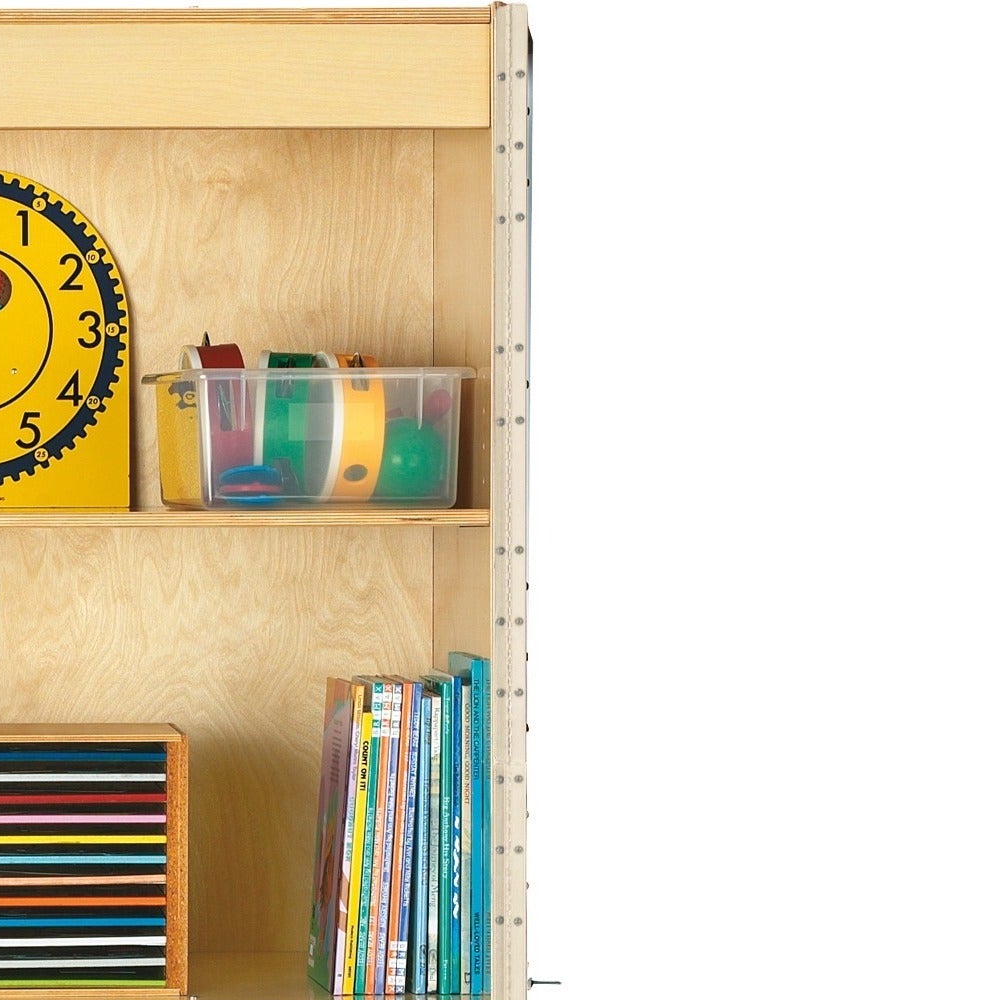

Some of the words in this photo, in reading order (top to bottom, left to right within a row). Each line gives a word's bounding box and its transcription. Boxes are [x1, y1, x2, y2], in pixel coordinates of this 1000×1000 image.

[16, 210, 29, 246] 1
[59, 253, 83, 291] 2
[78, 310, 102, 349] 3
[56, 369, 83, 407] 4
[15, 412, 41, 449] 5
[361, 740, 370, 766] COUNT
[463, 725, 471, 759] MORNING,
[359, 781, 367, 791] IT!
[360, 768, 368, 780] ON
[407, 807, 415, 836] Illustrated
[430, 845, 438, 873] Journey
[442, 857, 450, 878] Story
[429, 885, 438, 908] Meng
